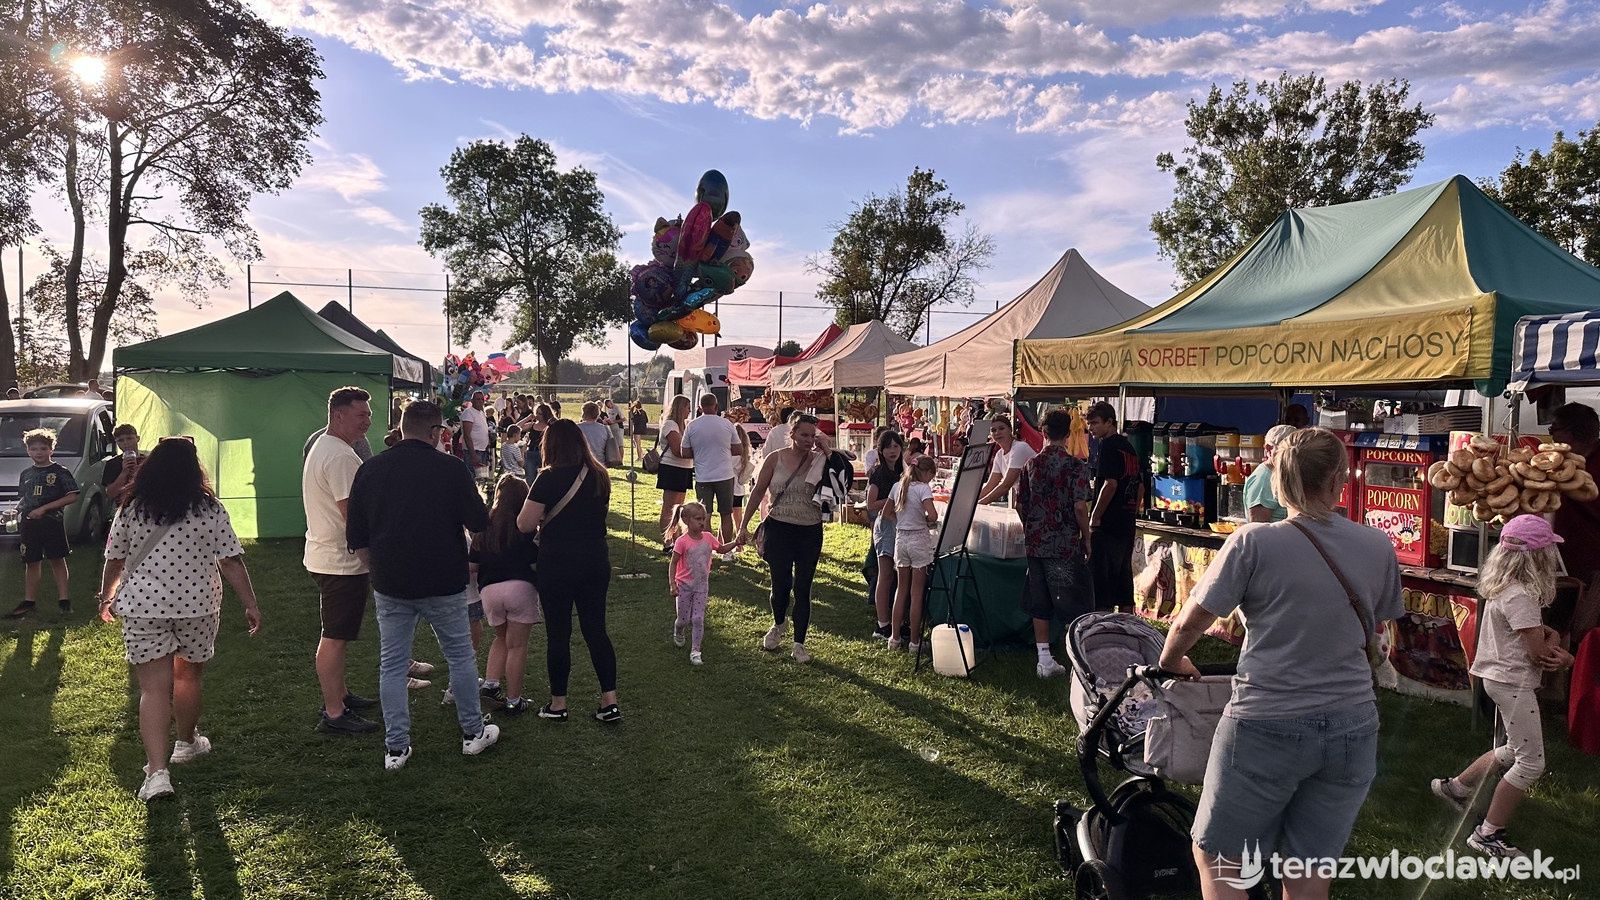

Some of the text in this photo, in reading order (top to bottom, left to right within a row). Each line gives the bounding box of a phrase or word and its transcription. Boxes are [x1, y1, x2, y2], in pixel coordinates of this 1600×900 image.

[1060, 349, 1133, 370] CUKROWA
[1138, 347, 1210, 367] SORBET
[1215, 341, 1322, 366] POPCORN
[1331, 330, 1464, 362] NACHOSY
[1366, 449, 1424, 463] POPCORN
[33, 485, 43, 496] 10
[1367, 489, 1420, 510] POPCORN
